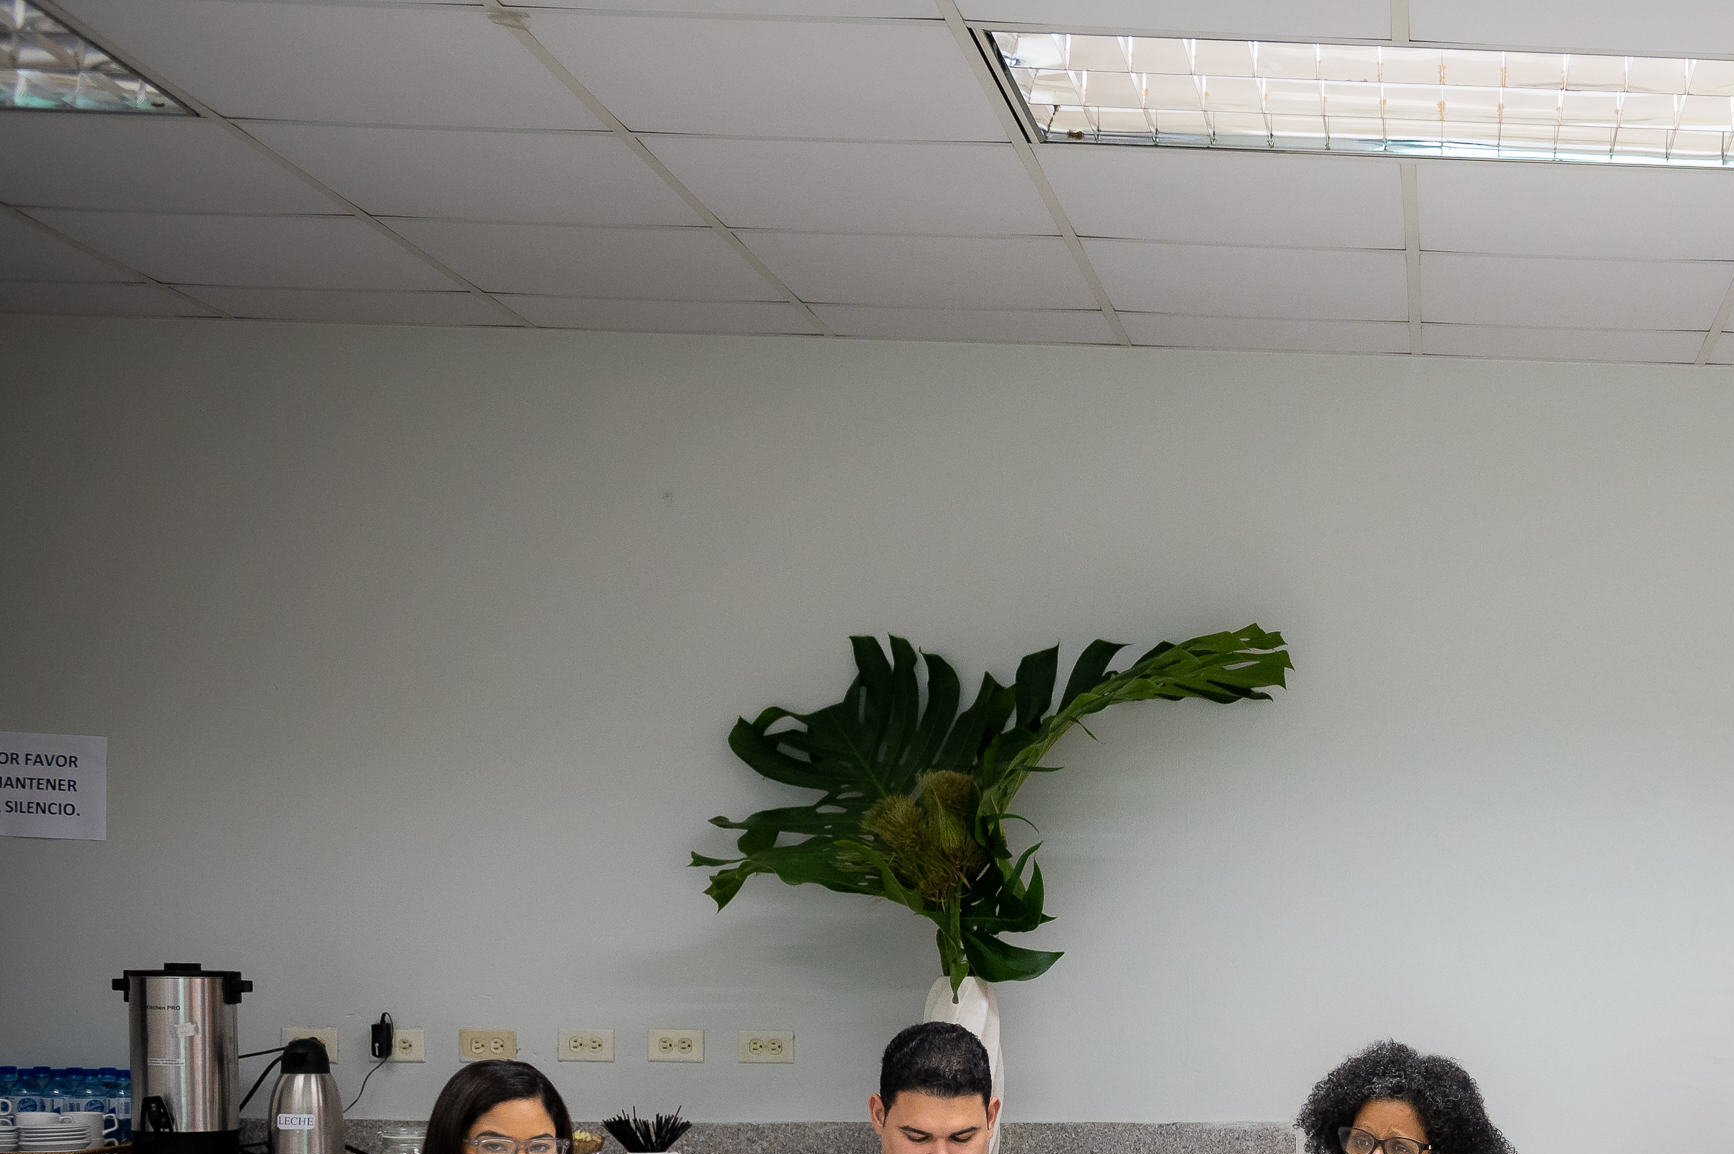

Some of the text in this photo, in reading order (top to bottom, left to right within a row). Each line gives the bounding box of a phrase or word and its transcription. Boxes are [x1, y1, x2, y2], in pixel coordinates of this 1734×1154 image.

[0, 752, 78, 768] OR FAVOR
[5, 800, 80, 817] SILENCIO.
[278, 1116, 314, 1126] LECHE
